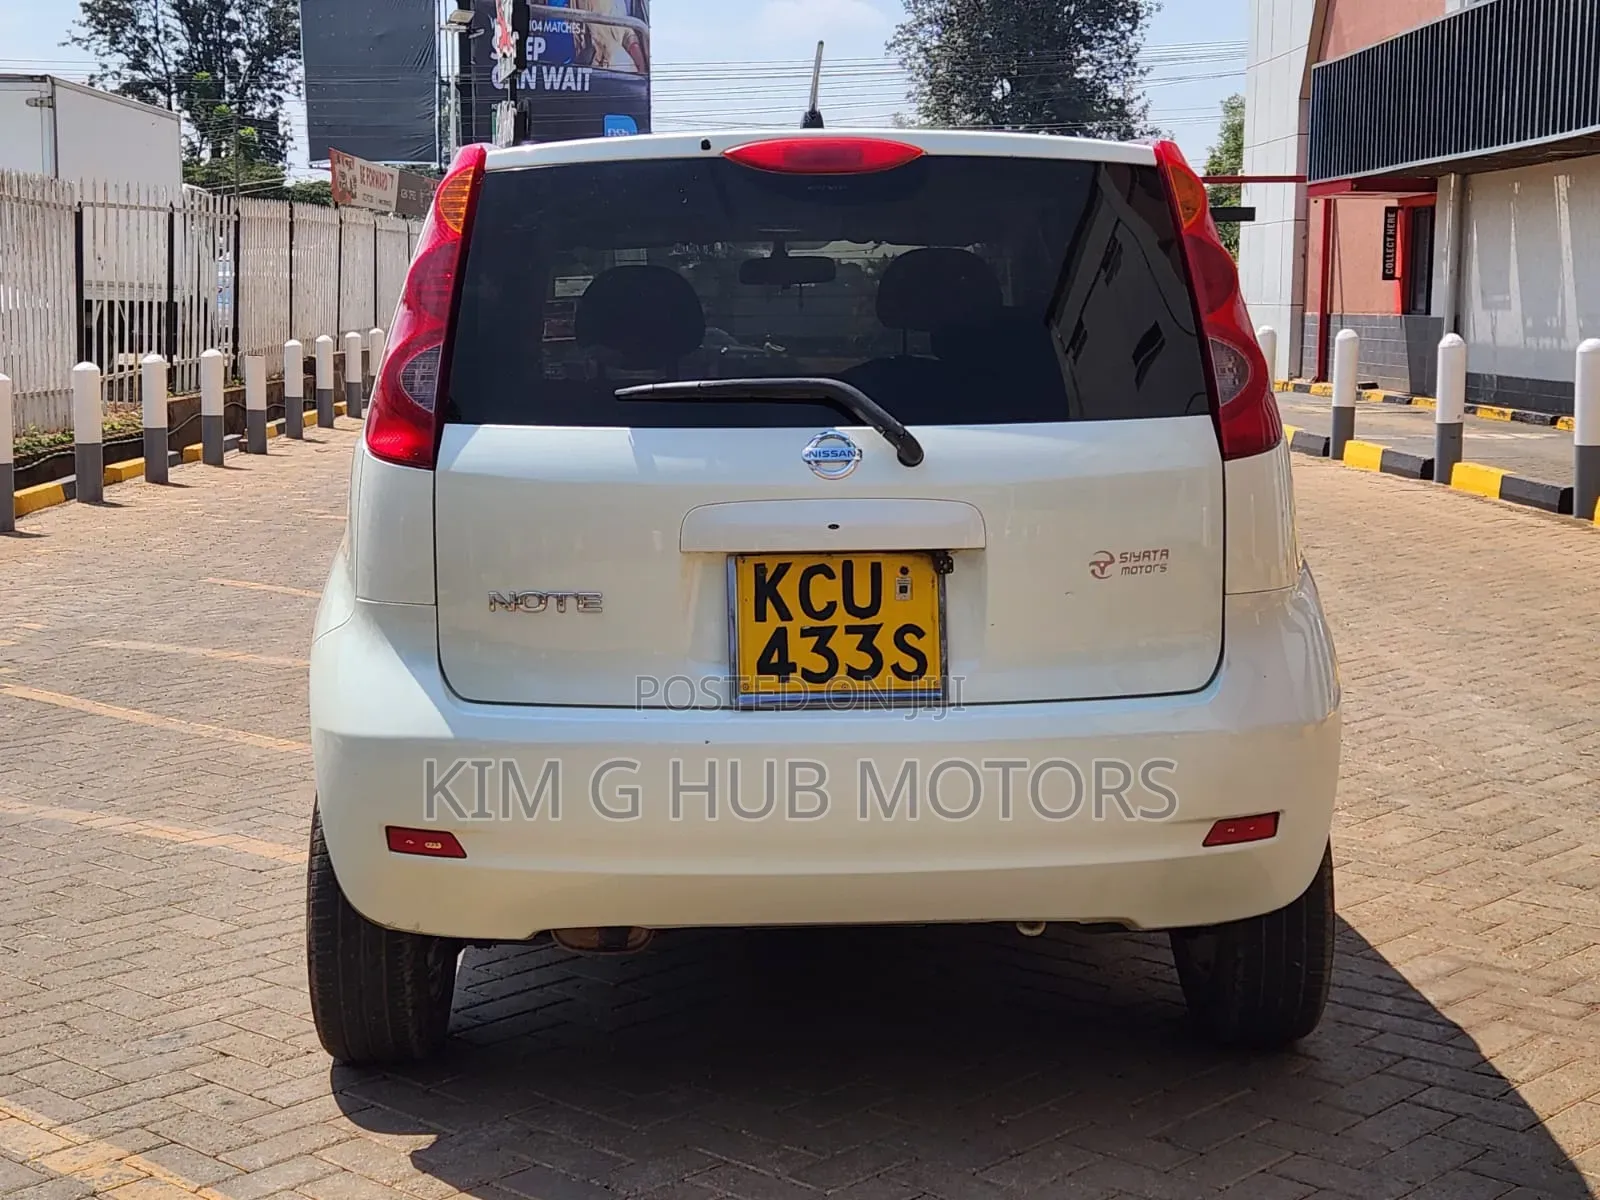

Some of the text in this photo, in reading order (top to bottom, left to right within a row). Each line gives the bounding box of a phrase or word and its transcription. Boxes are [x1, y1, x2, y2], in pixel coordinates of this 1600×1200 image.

[491, 65, 593, 91] CN WAIT
[1385, 211, 1396, 275] COLLECT HERE
[808, 449, 857, 459] NISSAN
[1119, 548, 1170, 564] SIYATA
[488, 590, 603, 613] NOTE
[753, 560, 883, 623] KCU
[756, 622, 929, 685] 433S
